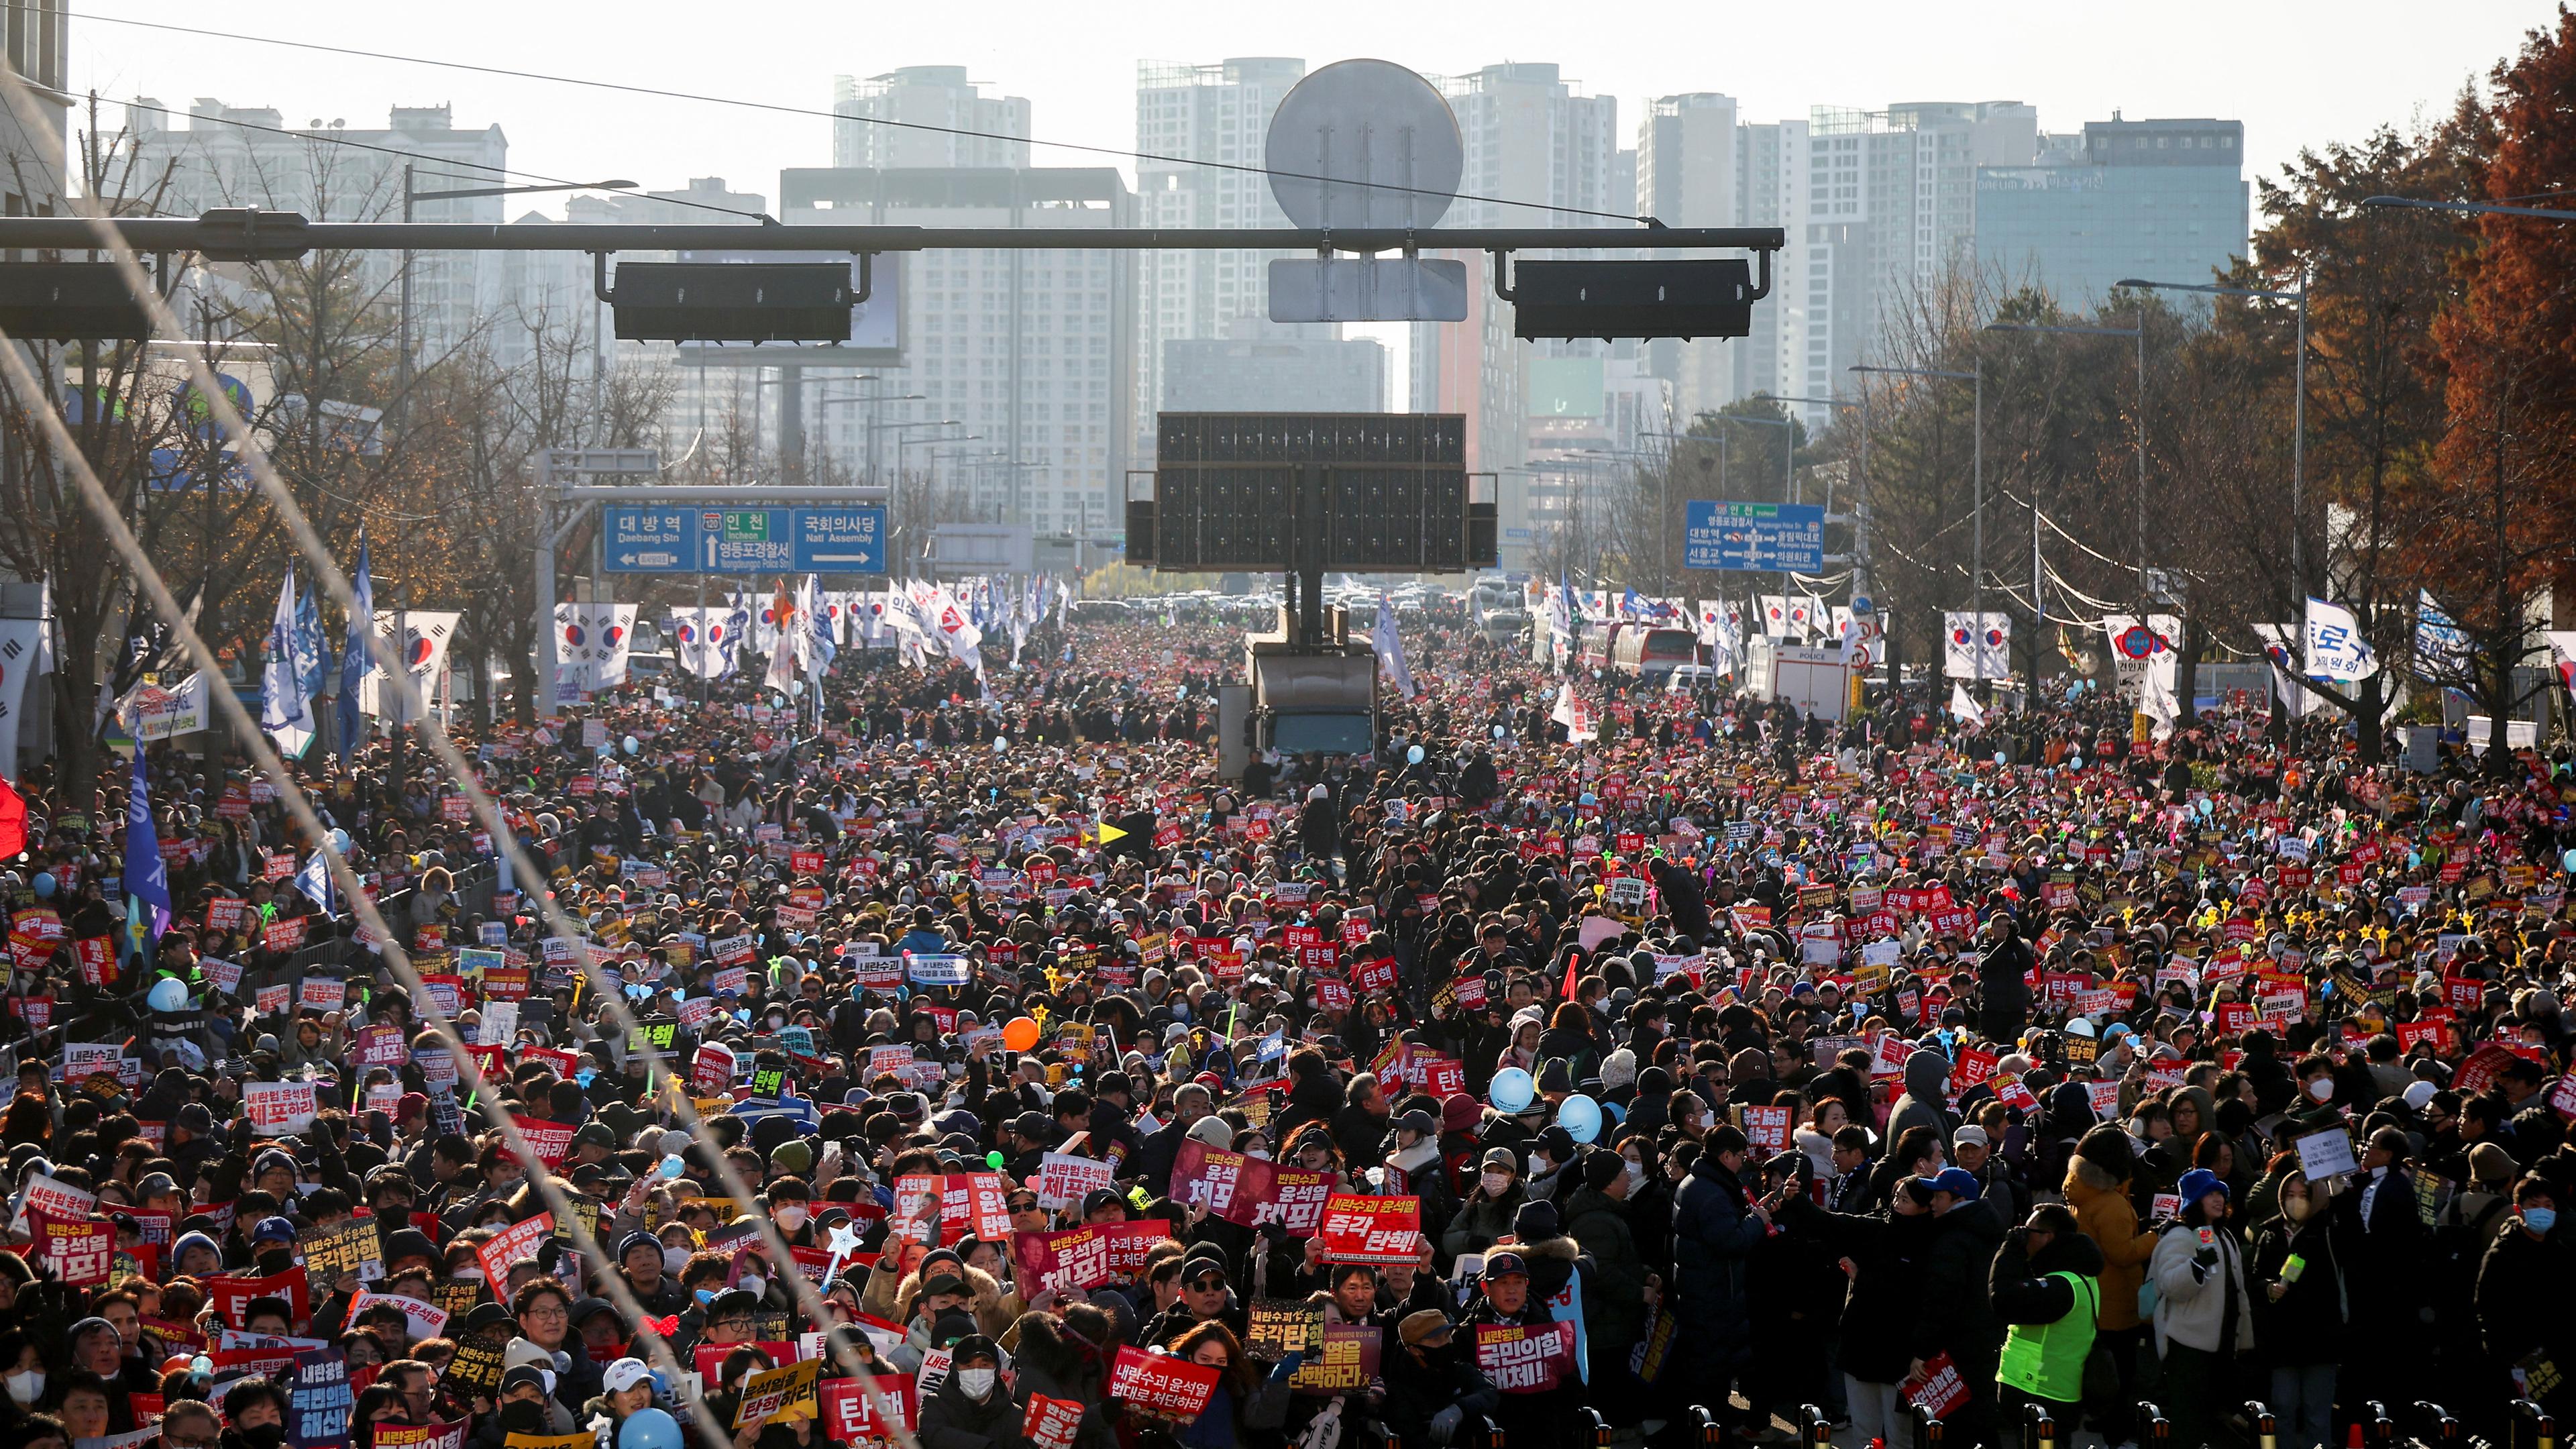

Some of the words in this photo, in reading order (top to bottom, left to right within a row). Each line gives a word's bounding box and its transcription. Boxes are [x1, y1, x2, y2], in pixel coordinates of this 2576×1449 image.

[706, 519, 718, 529] 120
[806, 515, 875, 533] 국회의사당
[618, 533, 660, 544] Daebang
[663, 533, 680, 543] Stn
[729, 531, 758, 539] Incheon
[828, 534, 873, 545] Assembly
[1778, 531, 1820, 543] 올림픽대로
[720, 542, 789, 559] 영등포경찰서
[1777, 551, 1811, 563] 의원회관
[763, 559, 779, 568] Police
[1799, 653, 1825, 661] POLICE
[2118, 661, 2151, 672] 견인지
[2088, 853, 2106, 863] 탄핵
[2356, 847, 2376, 861] 탄핵
[2285, 873, 2307, 885] 탄핵
[1887, 893, 1911, 908] 탄핵
[1871, 915, 1895, 930] 탄핵
[1937, 915, 1962, 930] 탄핵
[1289, 931, 1313, 945] 탄핵
[1346, 925, 1368, 938] 탄핵
[860, 959, 899, 971] 내란수괴
[989, 950, 1014, 963] 탄핵
[1306, 950, 1334, 965] 탄핵
[858, 973, 881, 983] 윤석열
[882, 972, 902, 982] 탄핵!
[912, 970, 938, 978] 윤석열을
[1364, 965, 1393, 988] 탄핵
[1323, 984, 1350, 1001] 탄핵
[2051, 980, 2084, 998] 탄핵
[2452, 985, 2477, 1002] 탄핵
[629, 1024, 676, 1051] 탄핵
[70, 1048, 117, 1063] 내란수괴
[754, 1070, 783, 1096] 탄핵
[247, 1091, 280, 1106] 내란범
[282, 1087, 312, 1102] 윤석열
[247, 1101, 315, 1127] 체포하라
[542, 1129, 573, 1142] 국민의힘
[1205, 1152, 1244, 1167] 반란수괴
[1046, 1163, 1081, 1177] 내란범
[1082, 1167, 1110, 1182] 윤석열
[1277, 1173, 1321, 1186] 반란수괴
[1279, 1184, 1330, 1203] 윤석열
[1327, 1197, 1377, 1213] 내란수괴
[1379, 1199, 1417, 1214] 윤석열
[1252, 1201, 1322, 1230] 체포!
[46, 1222, 93, 1238] 반란수괴
[894, 1219, 930, 1242] 구속
[1326, 1214, 1373, 1236] 즉각
[51, 1234, 109, 1256] 윤석열
[304, 1233, 343, 1254] 내란수괴
[352, 1222, 377, 1240] 윤석열
[1049, 1229, 1093, 1251] 반란수괴
[1364, 1230, 1419, 1252] 탄핵!
[1057, 1235, 1108, 1265] 윤석열
[1502, 1256, 1513, 1270] B
[1040, 1256, 1108, 1295] 체포!
[405, 1302, 443, 1326] 윤석열
[1251, 1310, 1293, 1323] 내란수괴
[1478, 1326, 1525, 1345] 내란공범
[458, 1345, 494, 1363] 내란수괴
[1479, 1329, 1563, 1368] 국민의힘
[302, 1359, 345, 1384] 내란공범
[1116, 1362, 1169, 1390] 내란수괴
[1169, 1377, 1210, 1398] 윤석열
[742, 1370, 798, 1399] 윤석열을
[292, 1383, 352, 1409] 국민의힘
[1111, 1381, 1150, 1402] 법대로
[1150, 1391, 1204, 1412] 처단하라
[839, 1389, 906, 1433] 탄핵
[301, 1408, 348, 1438] 해산!
[375, 1426, 430, 1446] 내란공범
